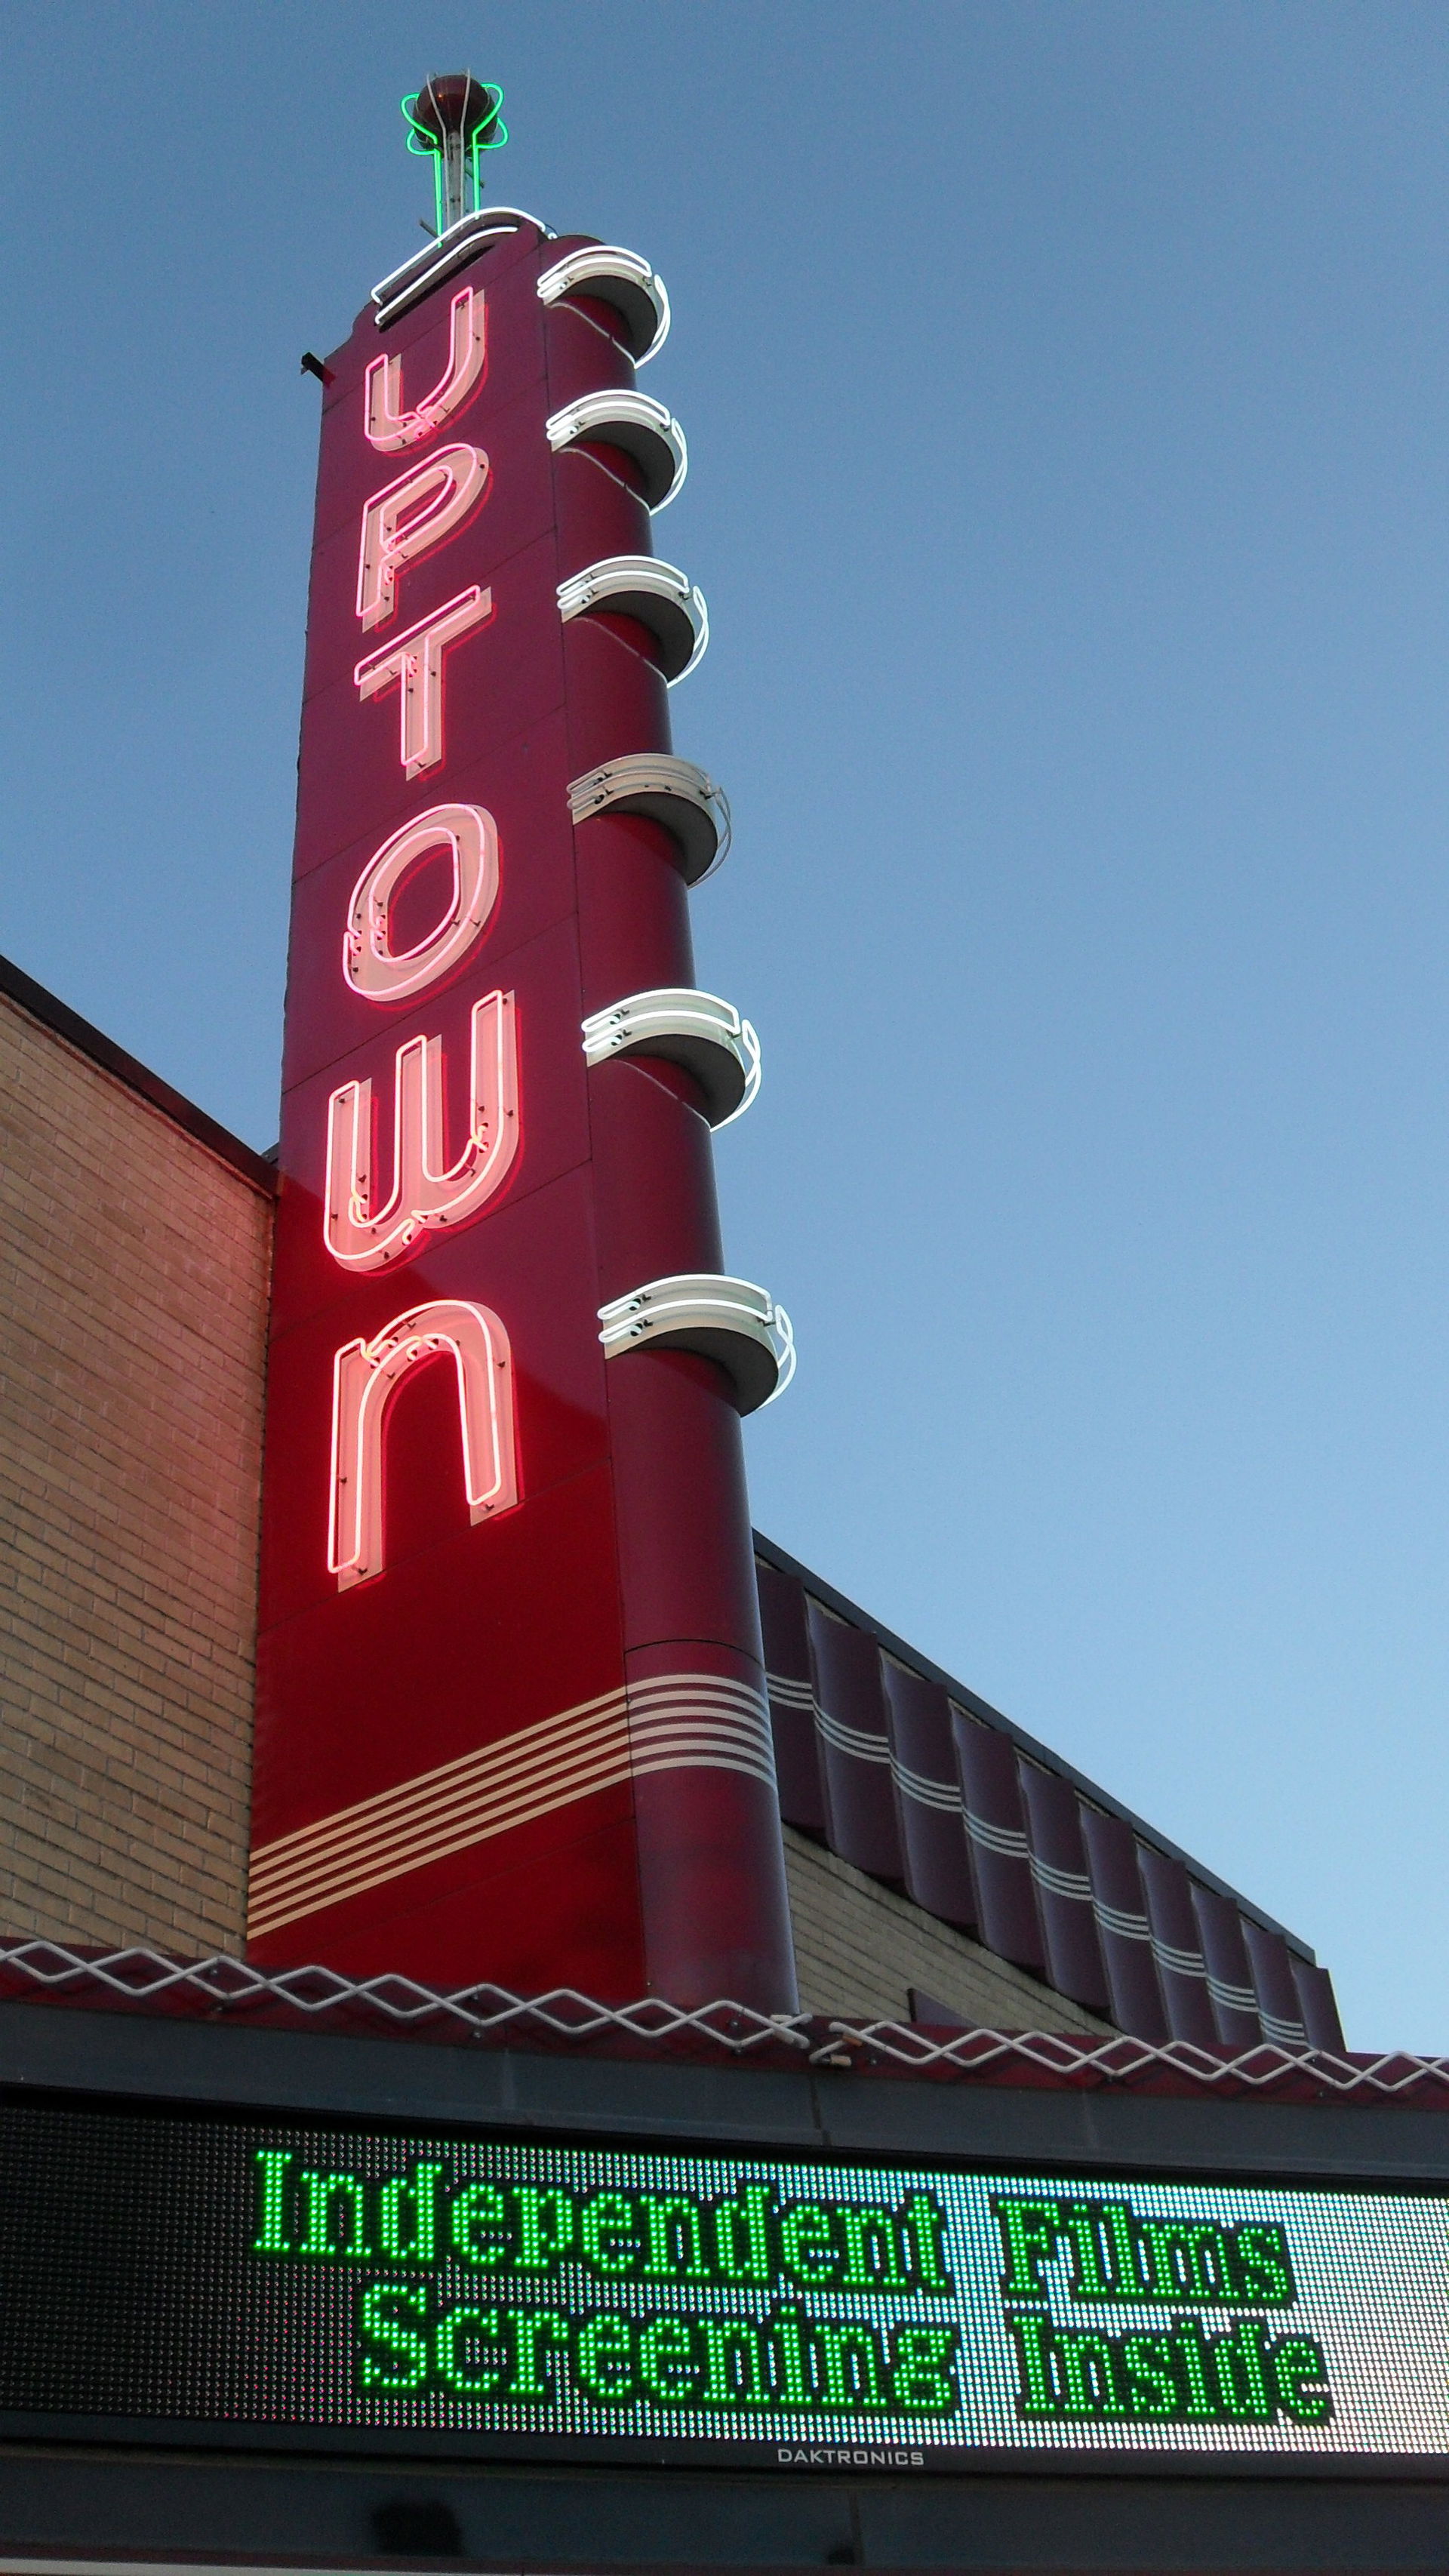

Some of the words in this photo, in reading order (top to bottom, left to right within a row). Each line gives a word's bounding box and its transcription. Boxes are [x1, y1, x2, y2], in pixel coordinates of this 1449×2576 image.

[254, 2149, 947, 2290] Independent
[997, 2199, 1291, 2302] Films
[362, 2283, 954, 2410] Screening
[1012, 2314, 1328, 2418] Inside
[777, 2448, 925, 2467] DAKTRONICS
